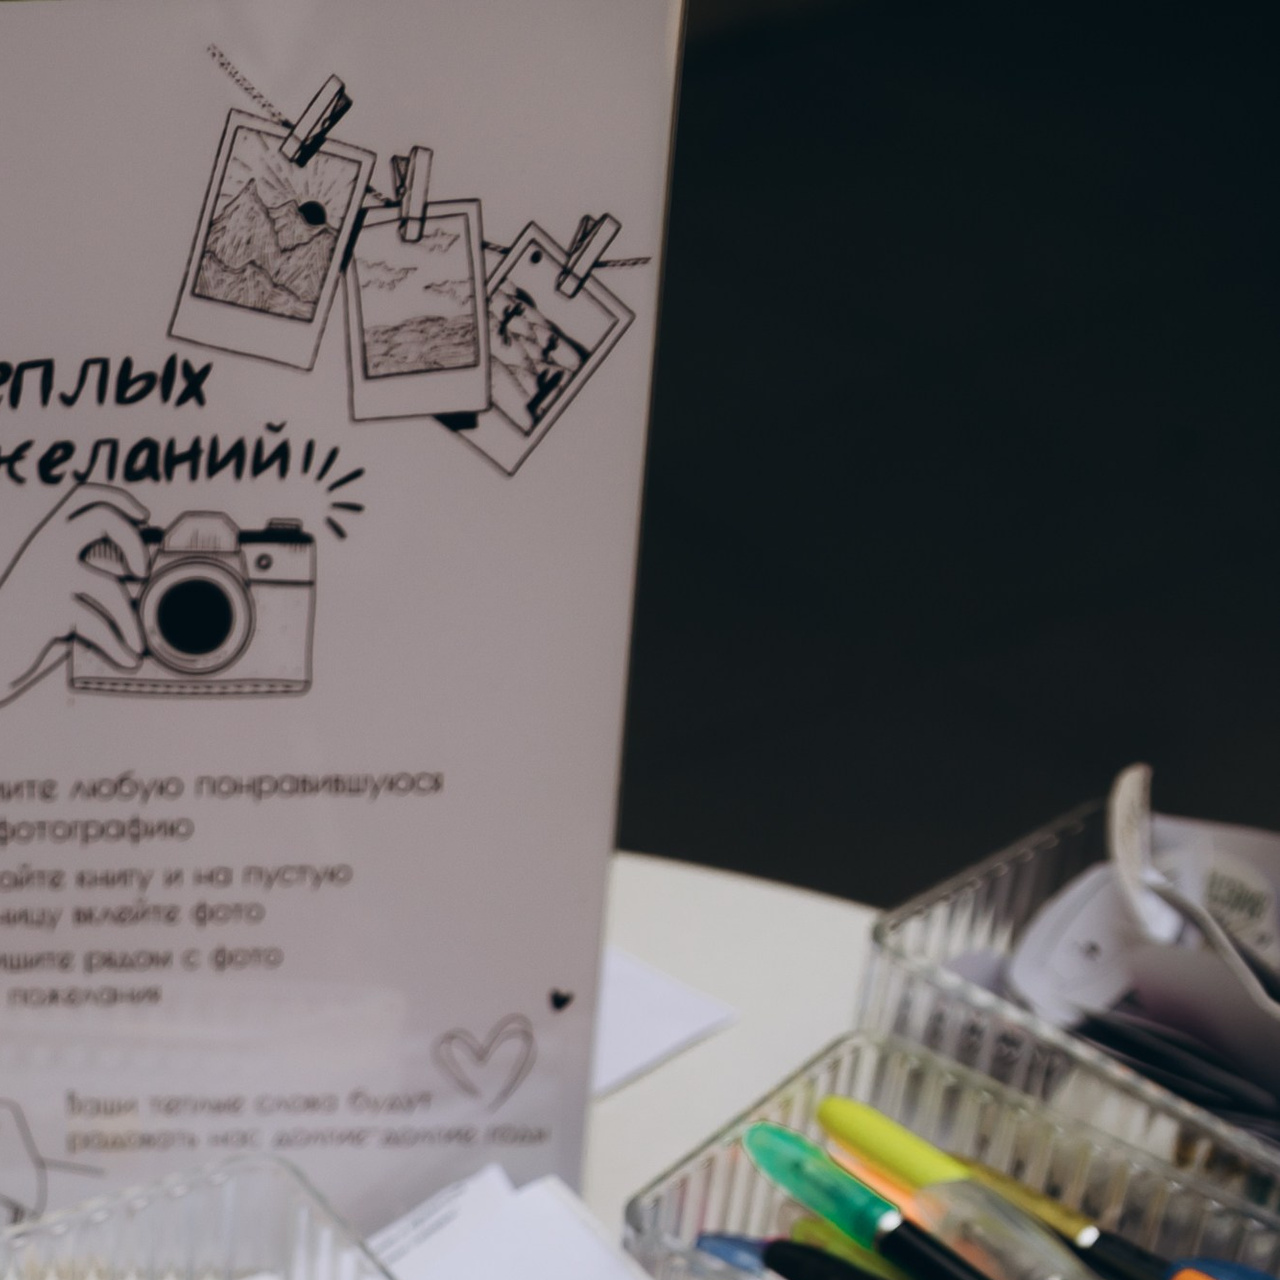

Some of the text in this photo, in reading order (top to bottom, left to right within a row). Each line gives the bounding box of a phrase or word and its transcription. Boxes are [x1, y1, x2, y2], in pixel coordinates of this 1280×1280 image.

[71, 769, 185, 806] любую
[195, 772, 445, 803] понравившуюся
[75, 868, 154, 902] книгу
[162, 868, 184, 891] и
[192, 866, 233, 889] на
[241, 863, 354, 893] пустую
[72, 901, 181, 929] вклейте
[190, 900, 266, 931] фото
[83, 949, 173, 977] рядом
[181, 948, 201, 972] с
[209, 945, 284, 976] фото
[7, 983, 162, 1011] пожелания
